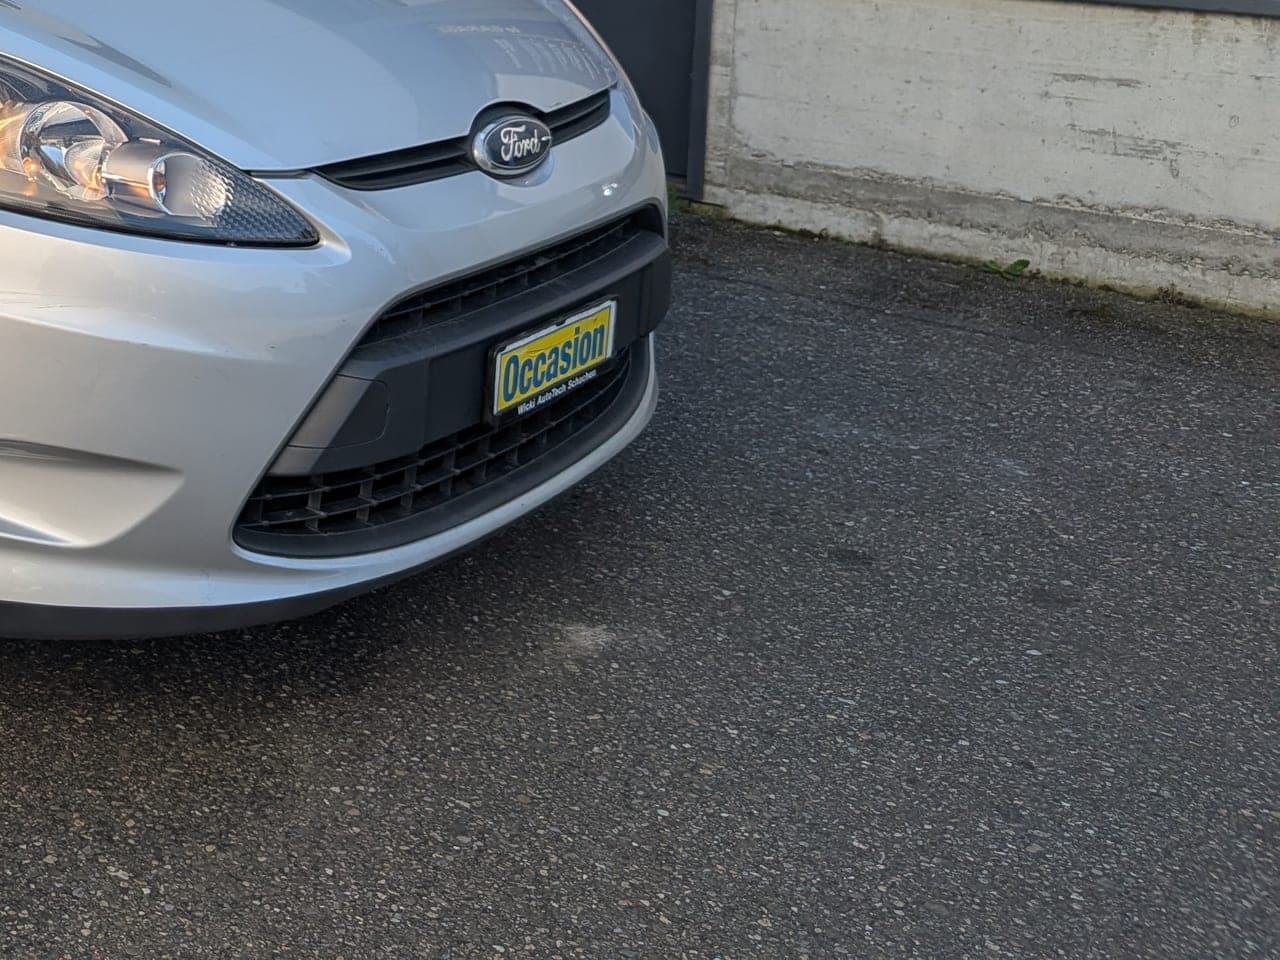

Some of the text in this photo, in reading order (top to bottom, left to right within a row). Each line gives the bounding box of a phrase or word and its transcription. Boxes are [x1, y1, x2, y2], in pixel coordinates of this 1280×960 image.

[500, 124, 541, 161] Ford
[503, 325, 605, 403] Occasion
[517, 399, 535, 415] Wicki
